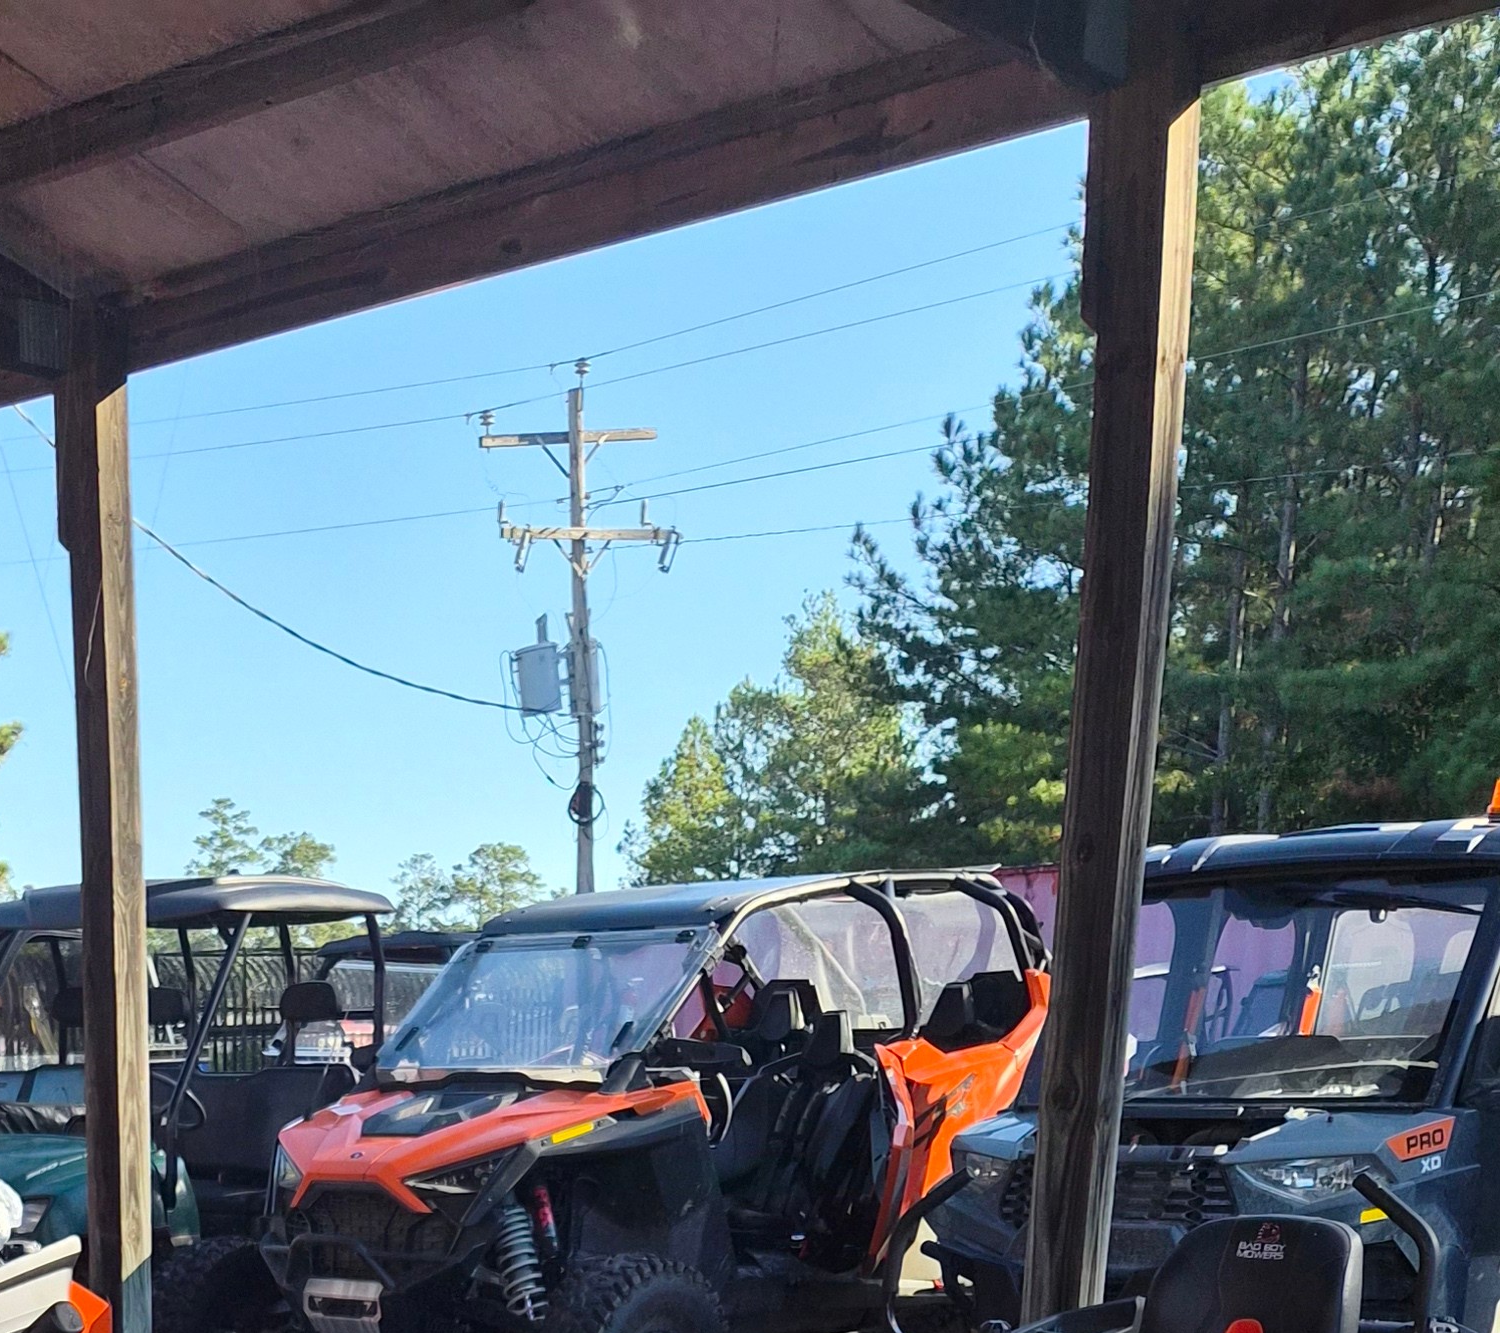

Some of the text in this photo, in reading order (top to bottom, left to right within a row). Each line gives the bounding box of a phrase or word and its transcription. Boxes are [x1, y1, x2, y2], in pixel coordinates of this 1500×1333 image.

[1406, 1128, 1444, 1154] PRO
[1421, 1155, 1442, 1174] XD
[1239, 1241, 1286, 1252] BAD BOY
[1236, 1249, 1285, 1260] MOWERS
